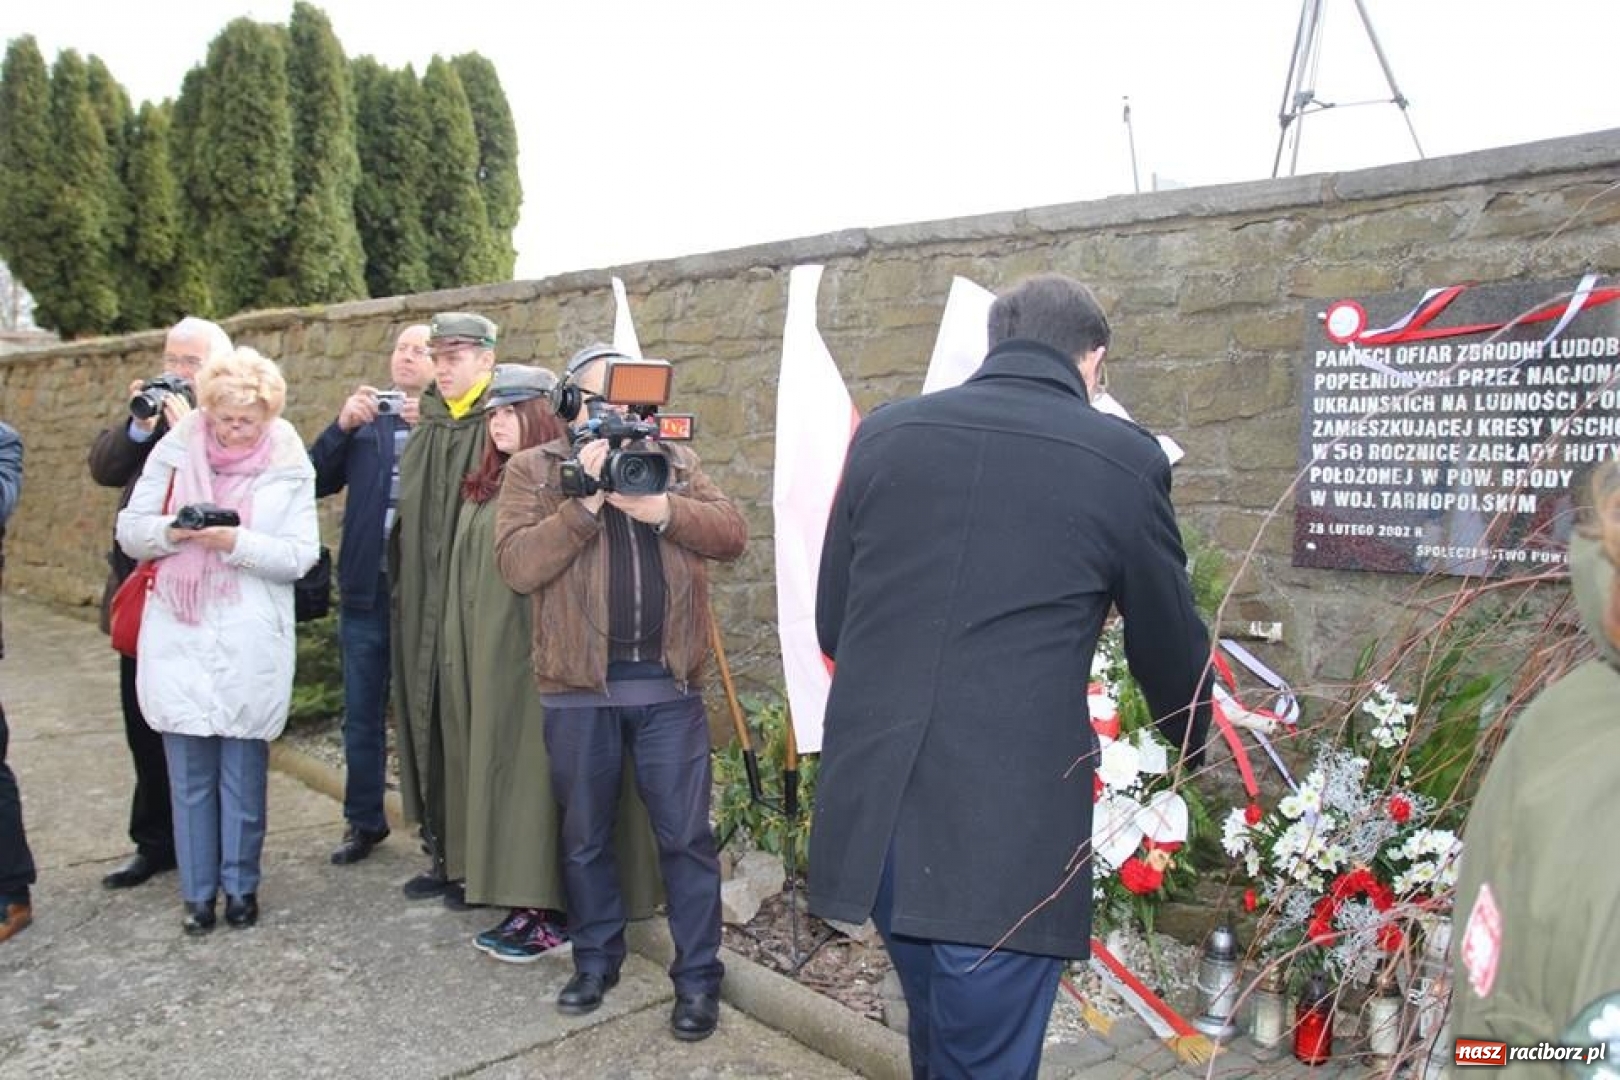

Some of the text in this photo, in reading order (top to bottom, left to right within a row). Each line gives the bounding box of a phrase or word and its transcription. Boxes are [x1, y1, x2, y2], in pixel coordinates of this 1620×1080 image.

[1396, 344, 1452, 364] OFIAR
[1457, 340, 1543, 363] ZBRODNI
[1314, 370, 1450, 391] POPEŁNIONYCH
[1457, 366, 1520, 387] PRZEZ
[1442, 393, 1467, 411] NA
[1474, 388, 1577, 412] LUDNOŚCI
[1585, 389, 1620, 411] PO
[1312, 418, 1472, 439] ZAMIESZKUJĄCEJ
[1477, 416, 1543, 438] KRESY
[1312, 442, 1328, 460] W
[1466, 442, 1558, 462] ZAGŁADY
[1310, 463, 1573, 489] POŁOŻONEJ W POW. BRODY
[1310, 489, 1536, 514] W WOJ. TARNOPOLSKIM
[1308, 522, 1324, 535] 28
[1328, 522, 1375, 536] LUTEGO
[1377, 524, 1410, 538] 2002
